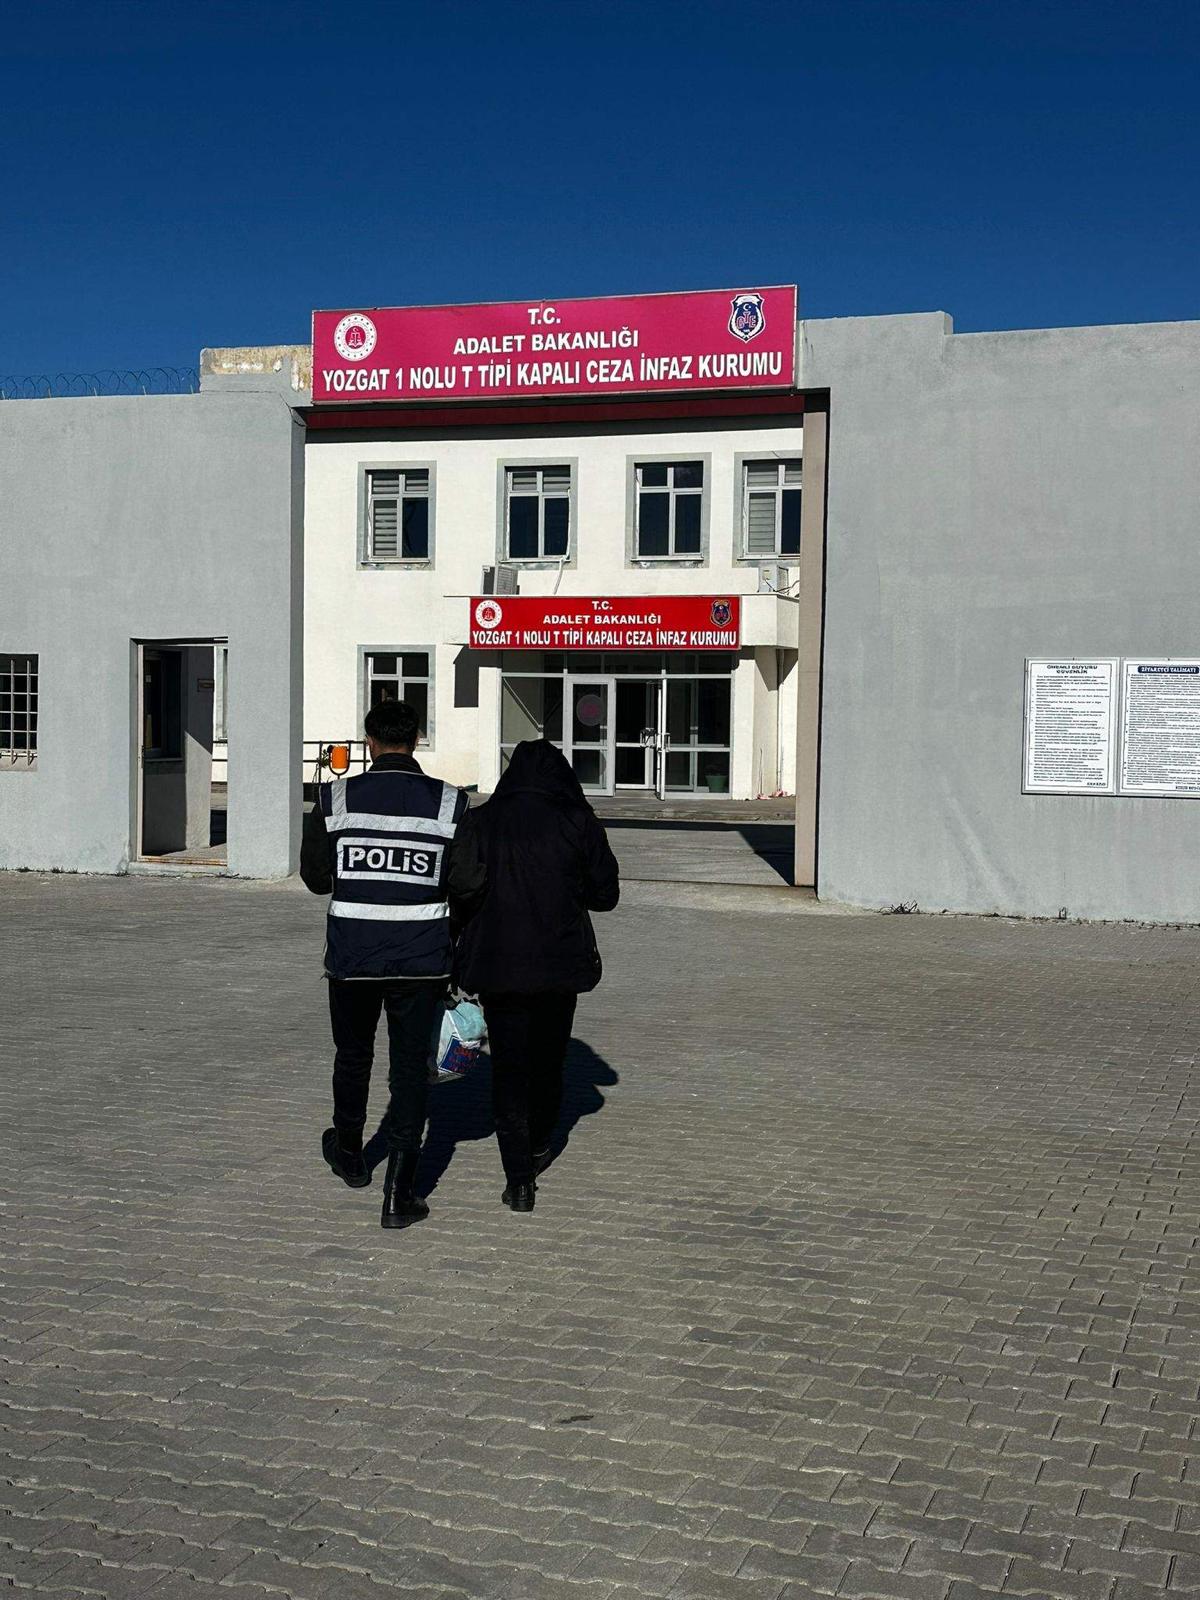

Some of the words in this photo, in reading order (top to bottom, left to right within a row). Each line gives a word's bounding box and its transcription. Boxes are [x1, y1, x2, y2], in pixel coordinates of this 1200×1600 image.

[528, 308, 560, 324] T.C.
[454, 335, 525, 354] ADALET
[532, 327, 638, 351] BAKANLIĞI
[323, 369, 390, 391] YOZGAT
[396, 368, 402, 389] 1
[410, 367, 456, 389] NOLU
[462, 366, 473, 387] T
[478, 359, 511, 386] TİPİ
[518, 361, 579, 385] KAPALI
[587, 359, 634, 383] CEZA
[640, 353, 692, 381] İNFAZ
[699, 352, 781, 378] KURUMU
[592, 601, 612, 610] T.C.
[543, 615, 590, 624] ADALET
[595, 613, 661, 624] BAKANLIĞI
[473, 631, 512, 644] YOZGAT
[514, 631, 520, 644] 1
[524, 631, 550, 644] NOLU
[554, 631, 560, 644] T
[563, 628, 582, 645] TİPİ
[587, 631, 622, 645] KAPALI
[626, 631, 653, 645] CEZA
[657, 628, 687, 645] İNFAZ
[690, 631, 736, 645] KURUMU
